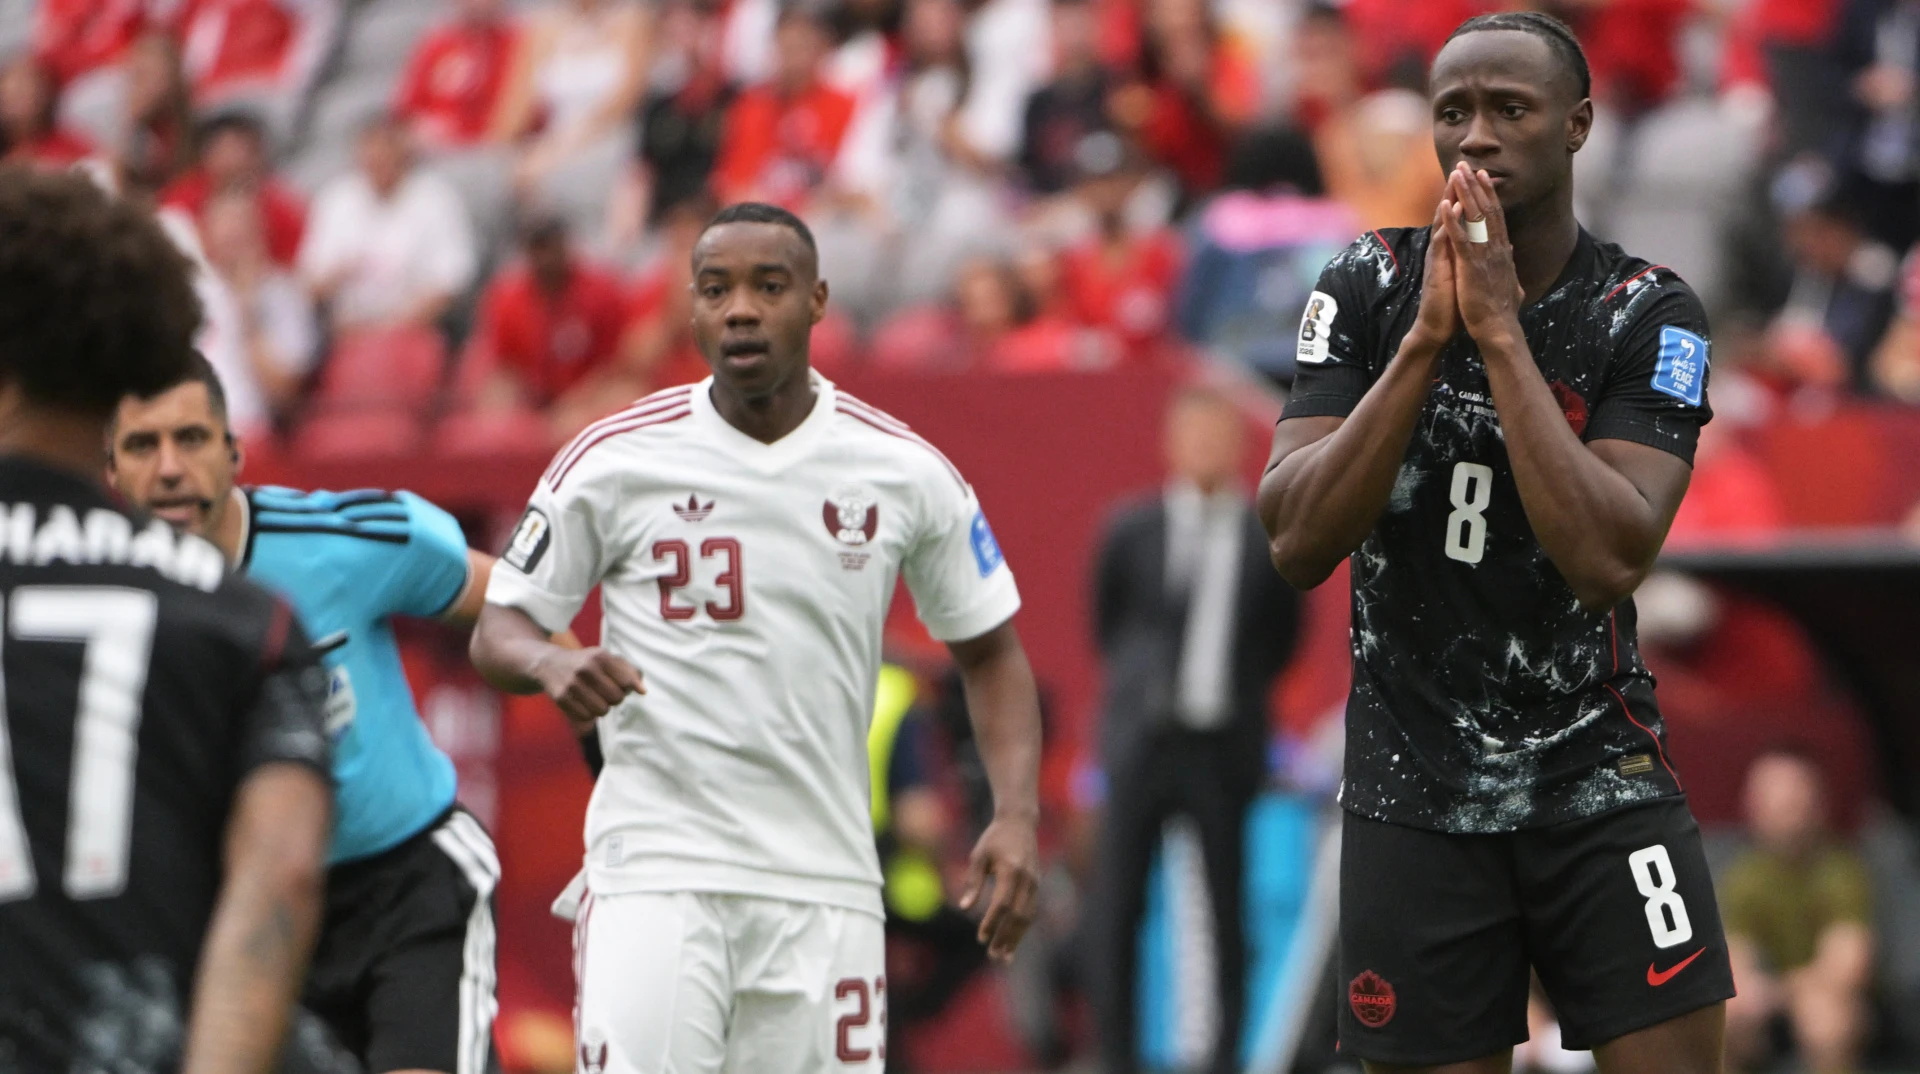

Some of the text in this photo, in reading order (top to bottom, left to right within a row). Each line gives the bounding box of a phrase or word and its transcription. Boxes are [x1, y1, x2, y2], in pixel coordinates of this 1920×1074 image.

[1458, 390, 1484, 403] CANADA
[1670, 367, 1694, 387] PEACE
[1673, 381, 1687, 392] FIFA
[1444, 462, 1493, 563] 8
[652, 537, 744, 622] 23
[1628, 844, 1692, 949] 8
[834, 975, 886, 1064] 2
[1351, 994, 1393, 1005] CANADA
